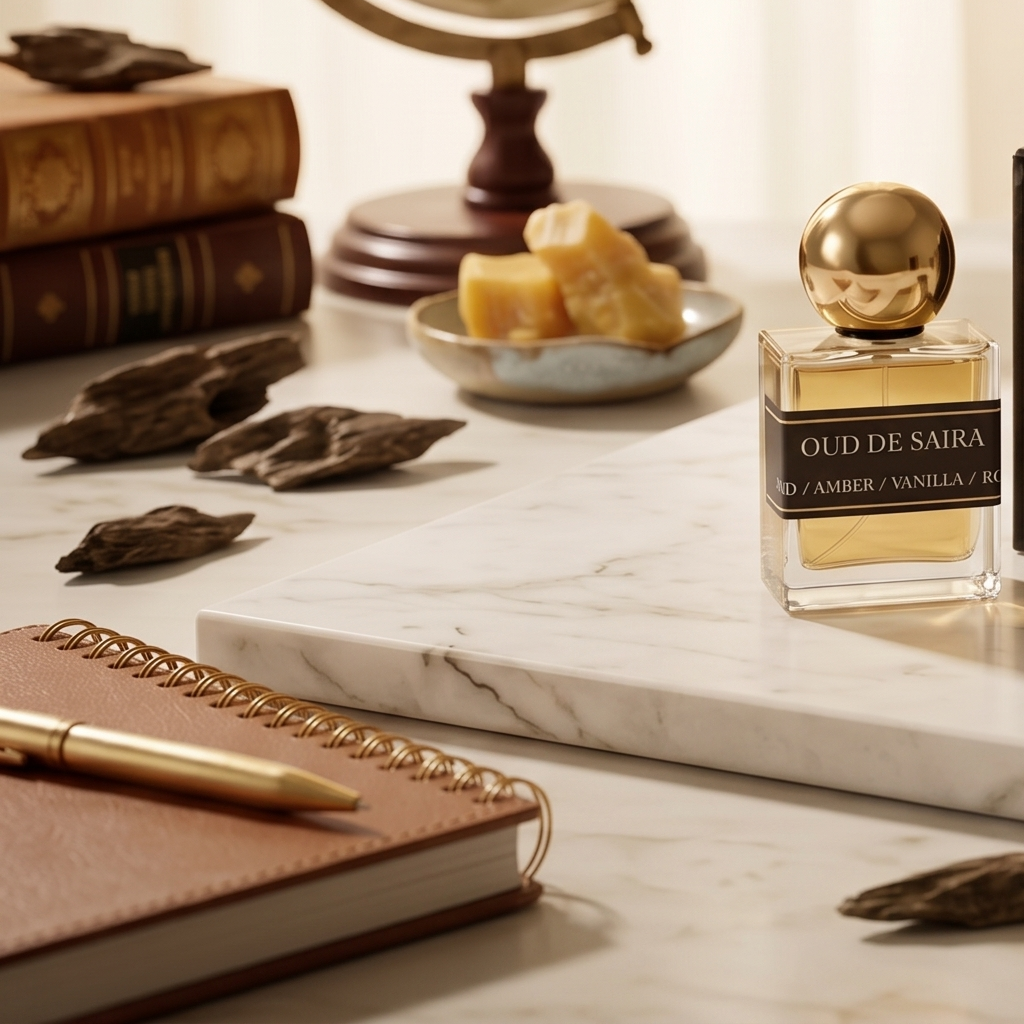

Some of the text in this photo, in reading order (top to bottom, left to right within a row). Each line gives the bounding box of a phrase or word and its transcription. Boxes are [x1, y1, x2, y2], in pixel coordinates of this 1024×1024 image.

[801, 428, 985, 457] OUD DE SAIRA
[802, 481, 811, 496] /
[813, 478, 874, 495] AMBER
[879, 477, 887, 492] /
[891, 472, 964, 490] VANILLA
[968, 471, 977, 485] /
